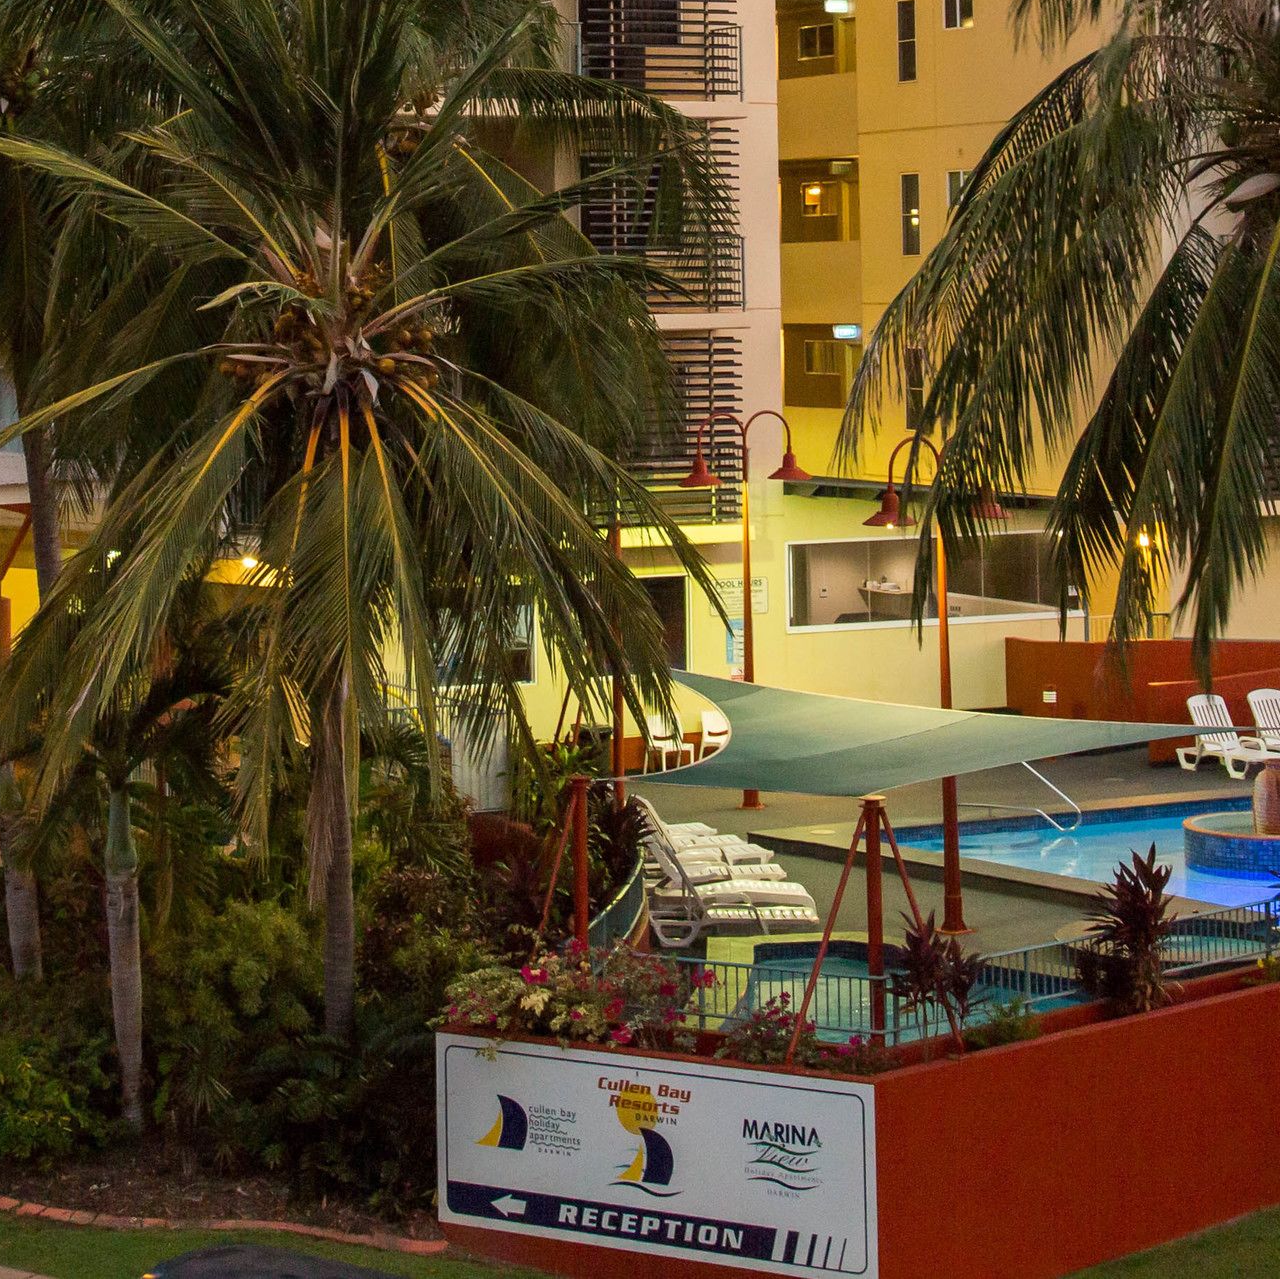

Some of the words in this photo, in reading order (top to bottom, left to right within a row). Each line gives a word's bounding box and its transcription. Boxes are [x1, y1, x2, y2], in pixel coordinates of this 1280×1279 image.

[738, 579, 762, 587] HRS
[598, 1077, 651, 1094] Cullen
[658, 1084, 691, 1102] Bay
[529, 1104, 557, 1115] cullen
[560, 1108, 576, 1120] bay
[609, 1095, 680, 1114] Resorts
[529, 1118, 560, 1130] holiday
[635, 1113, 677, 1125] DARWIN
[530, 1132, 580, 1145] apartments
[742, 1119, 822, 1147] MARINA
[558, 1203, 744, 1249] RECEPTION
